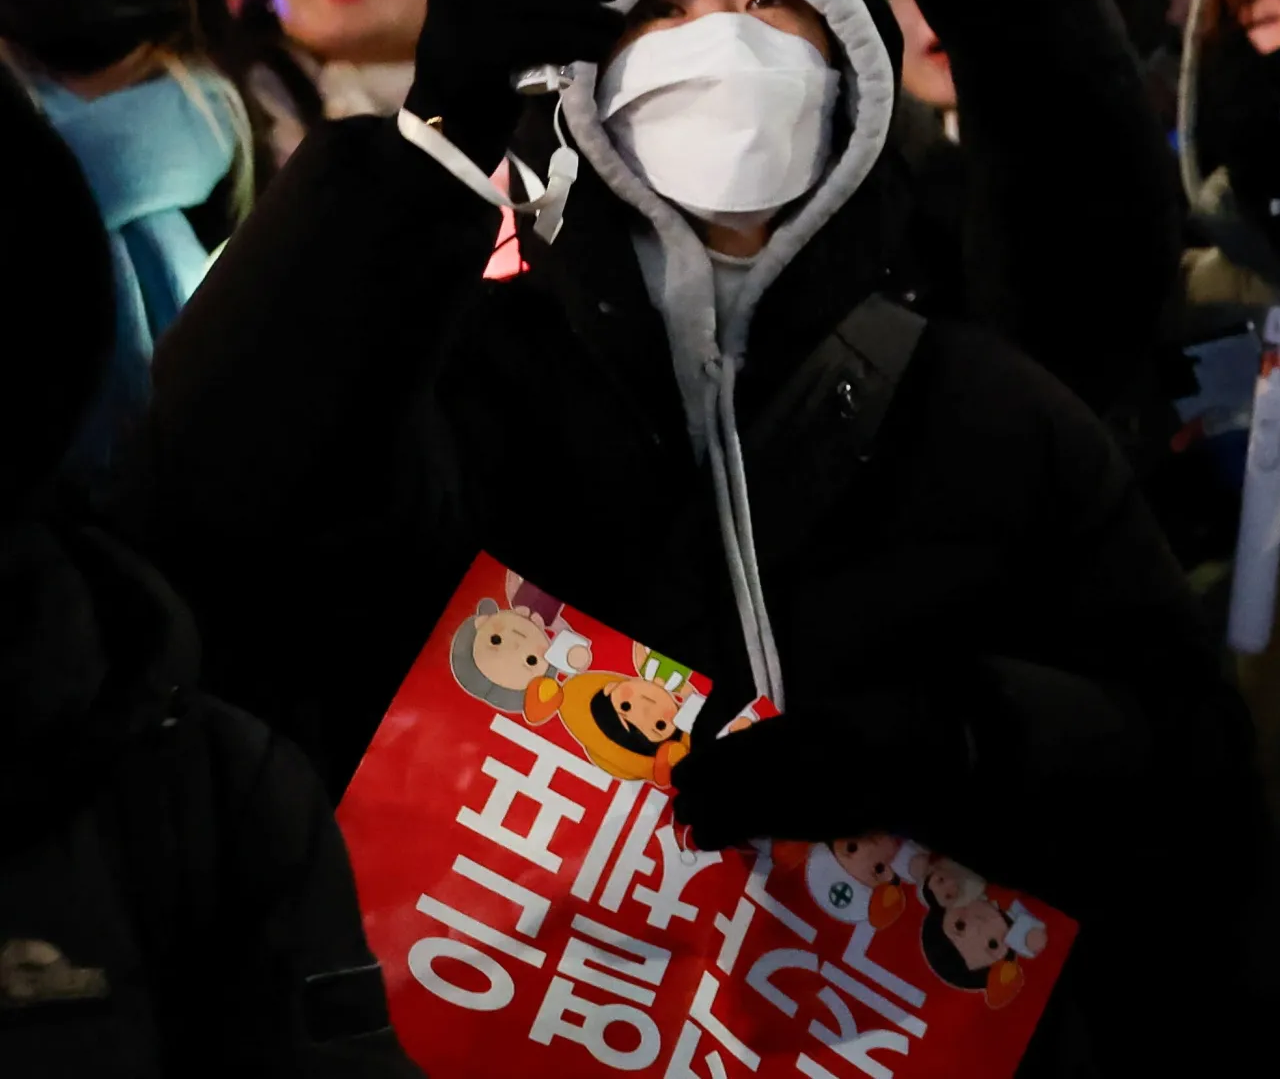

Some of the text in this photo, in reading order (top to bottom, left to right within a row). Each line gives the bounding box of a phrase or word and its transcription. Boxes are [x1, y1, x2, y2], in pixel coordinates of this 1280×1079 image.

[407, 851, 843, 1079] 석열은
[454, 714, 929, 1079] 즉각 체포
